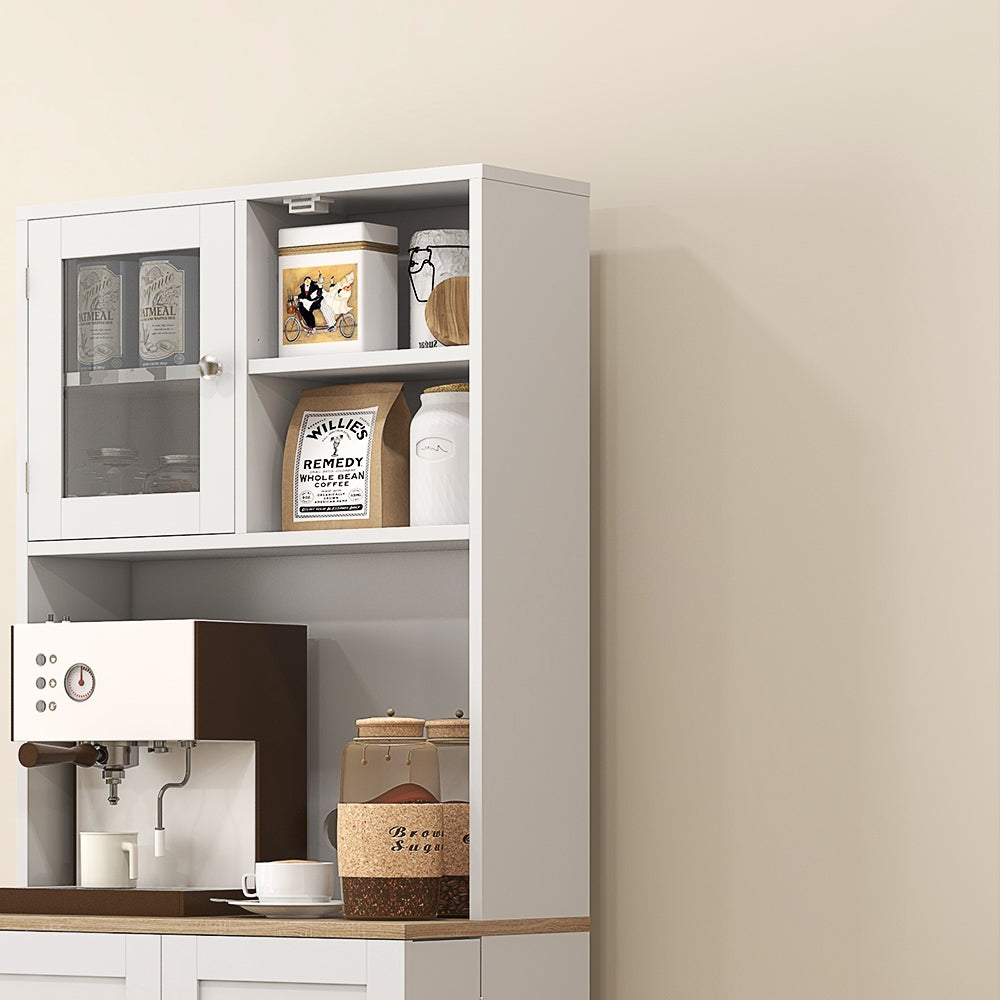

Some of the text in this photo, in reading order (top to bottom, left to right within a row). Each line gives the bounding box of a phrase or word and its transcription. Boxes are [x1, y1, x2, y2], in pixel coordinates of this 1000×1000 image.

[79, 311, 114, 321] ATMEAL
[141, 306, 176, 317] ATMEAL
[306, 417, 368, 440] WILLIE'S
[303, 457, 364, 470] REMEDY
[299, 474, 334, 483] WHOLE
[337, 470, 365, 480] BEAN
[389, 826, 444, 838] Brow
